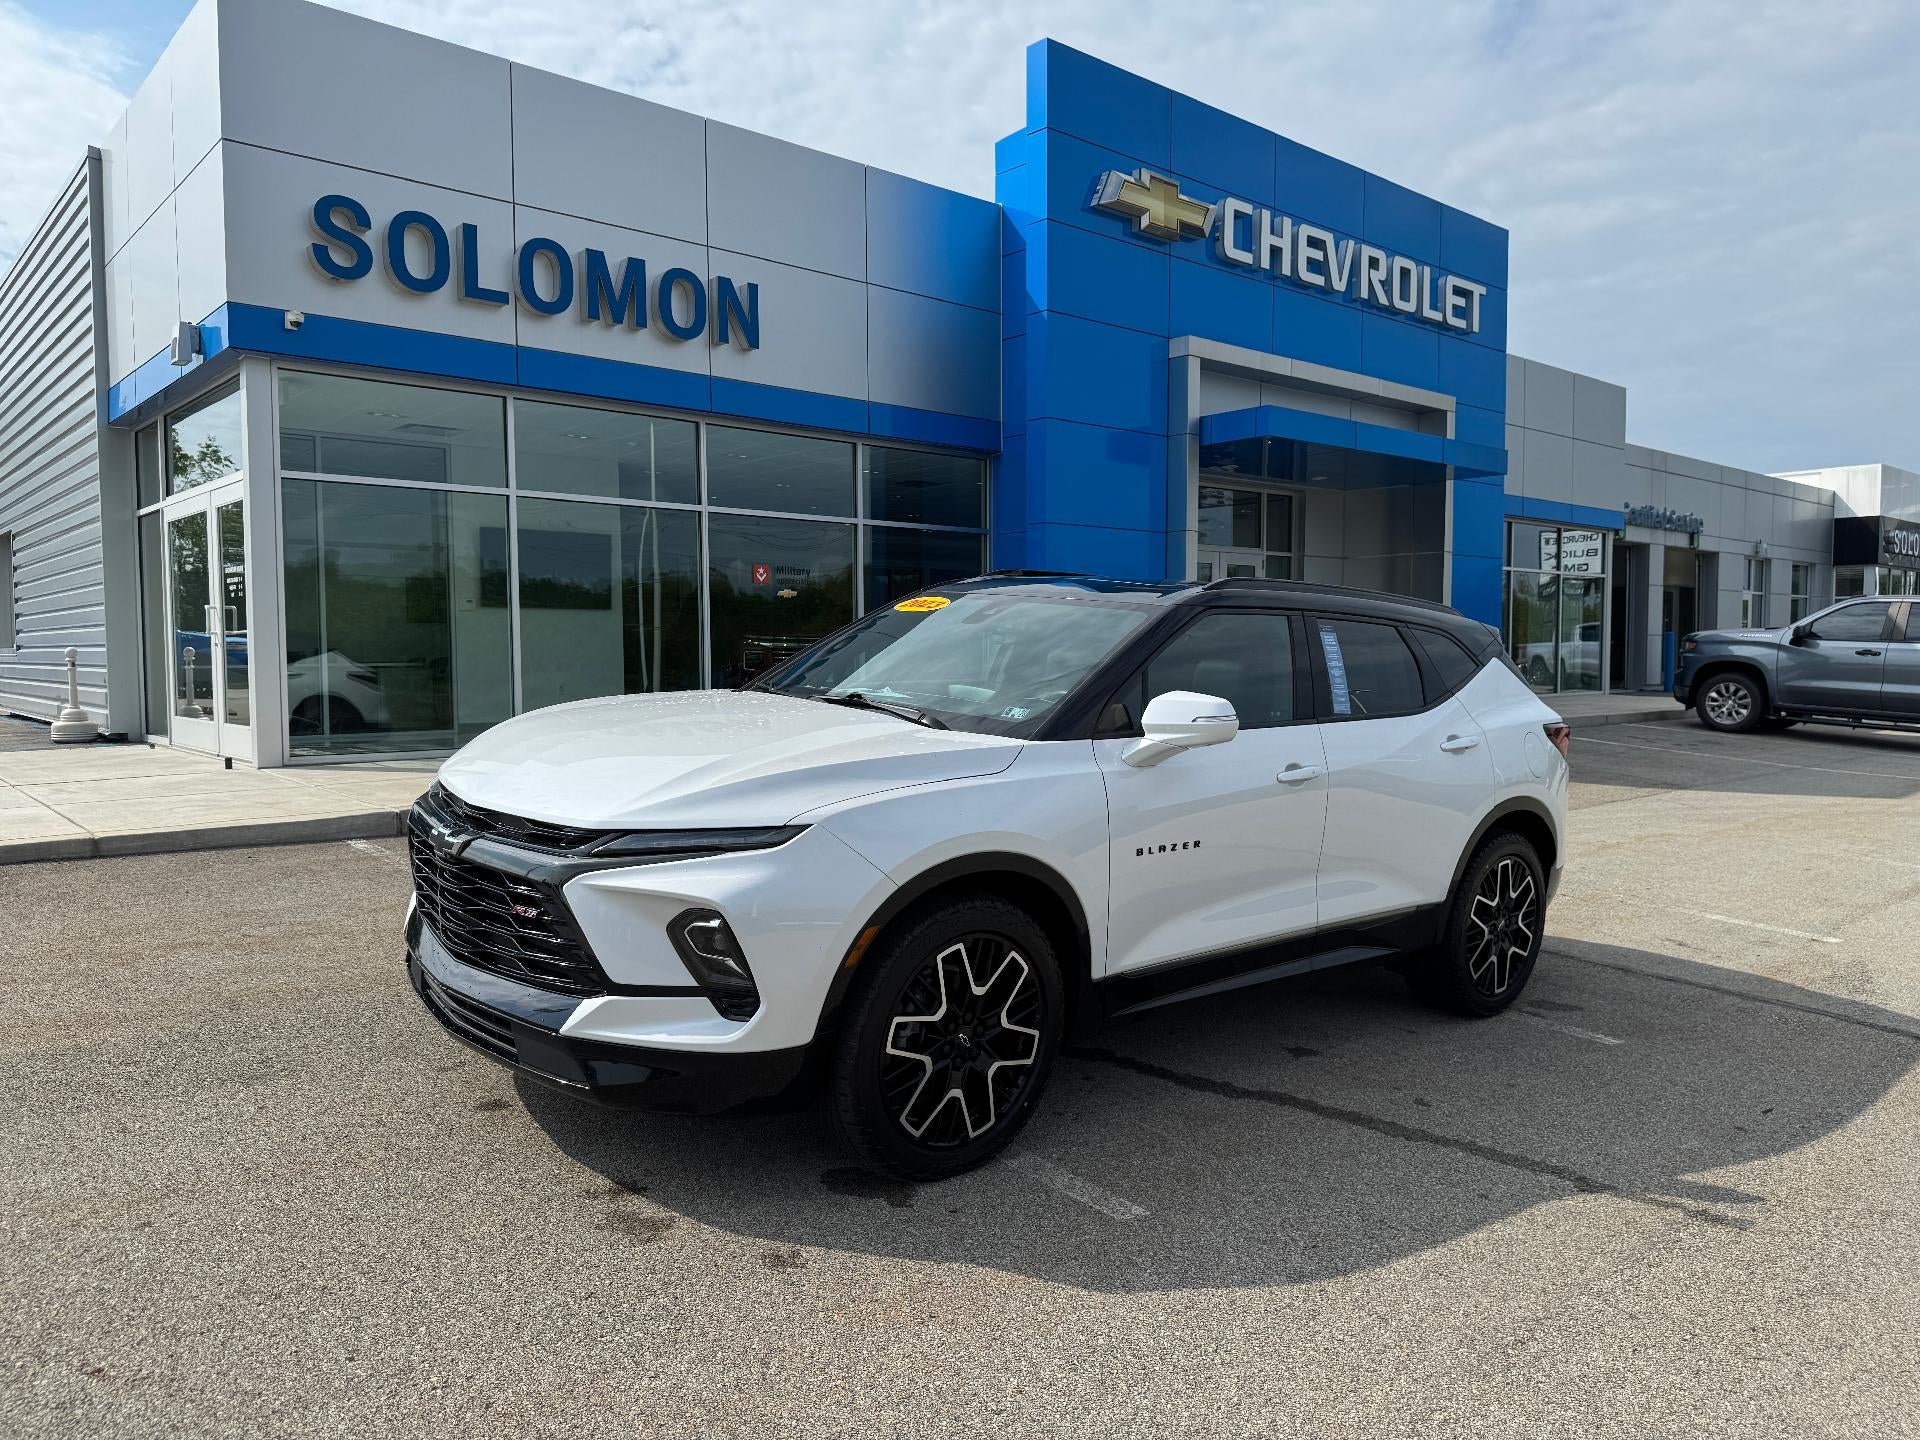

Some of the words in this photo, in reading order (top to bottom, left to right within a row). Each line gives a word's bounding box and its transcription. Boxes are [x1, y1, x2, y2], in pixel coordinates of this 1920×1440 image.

[307, 194, 760, 351] SOLOMON
[1217, 196, 1487, 334] CHEVROLET
[1893, 529, 1920, 557] SOLO
[776, 564, 811, 577] Military
[1135, 839, 1201, 857] BLAZER
